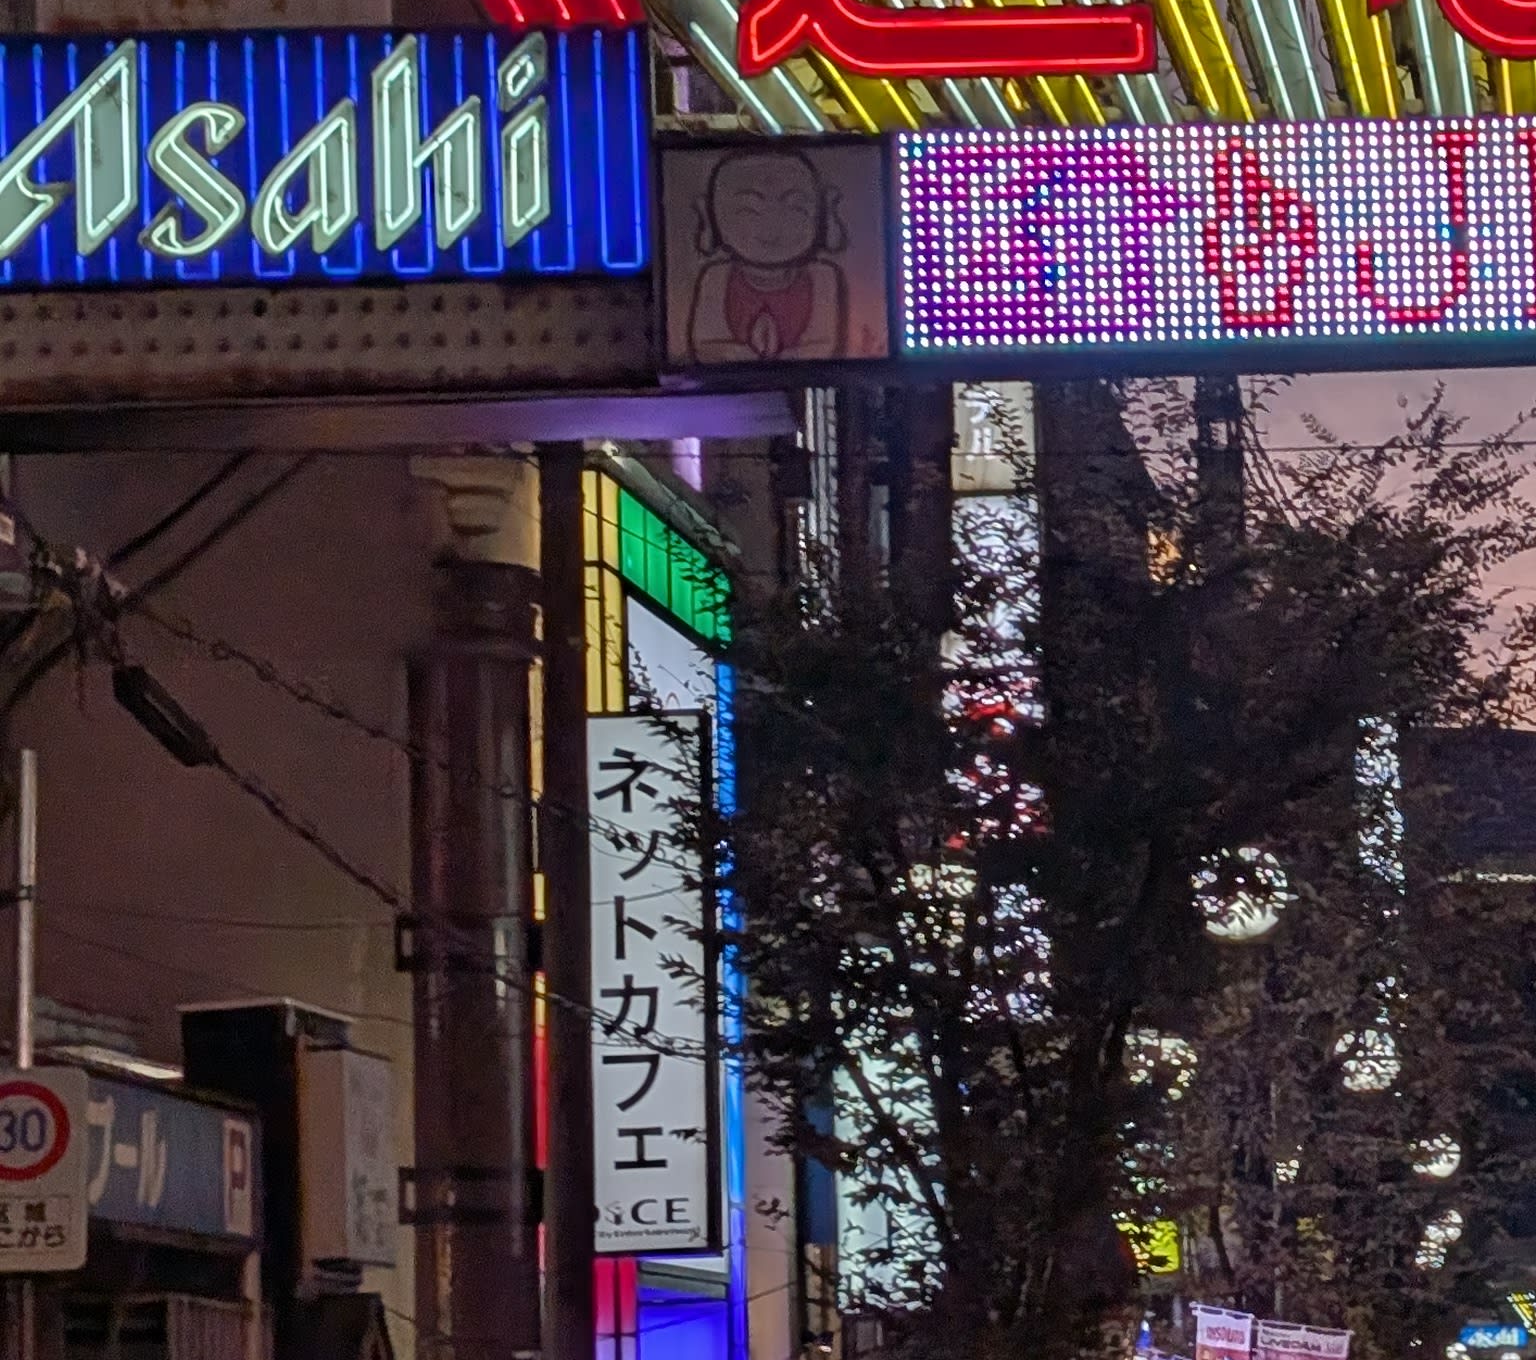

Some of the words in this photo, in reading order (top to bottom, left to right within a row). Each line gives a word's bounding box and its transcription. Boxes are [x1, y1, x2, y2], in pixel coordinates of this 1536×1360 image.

[0, 33, 550, 257] Asahi
[594, 746, 669, 1172] ネットカフェ
[0, 1106, 48, 1154] 30
